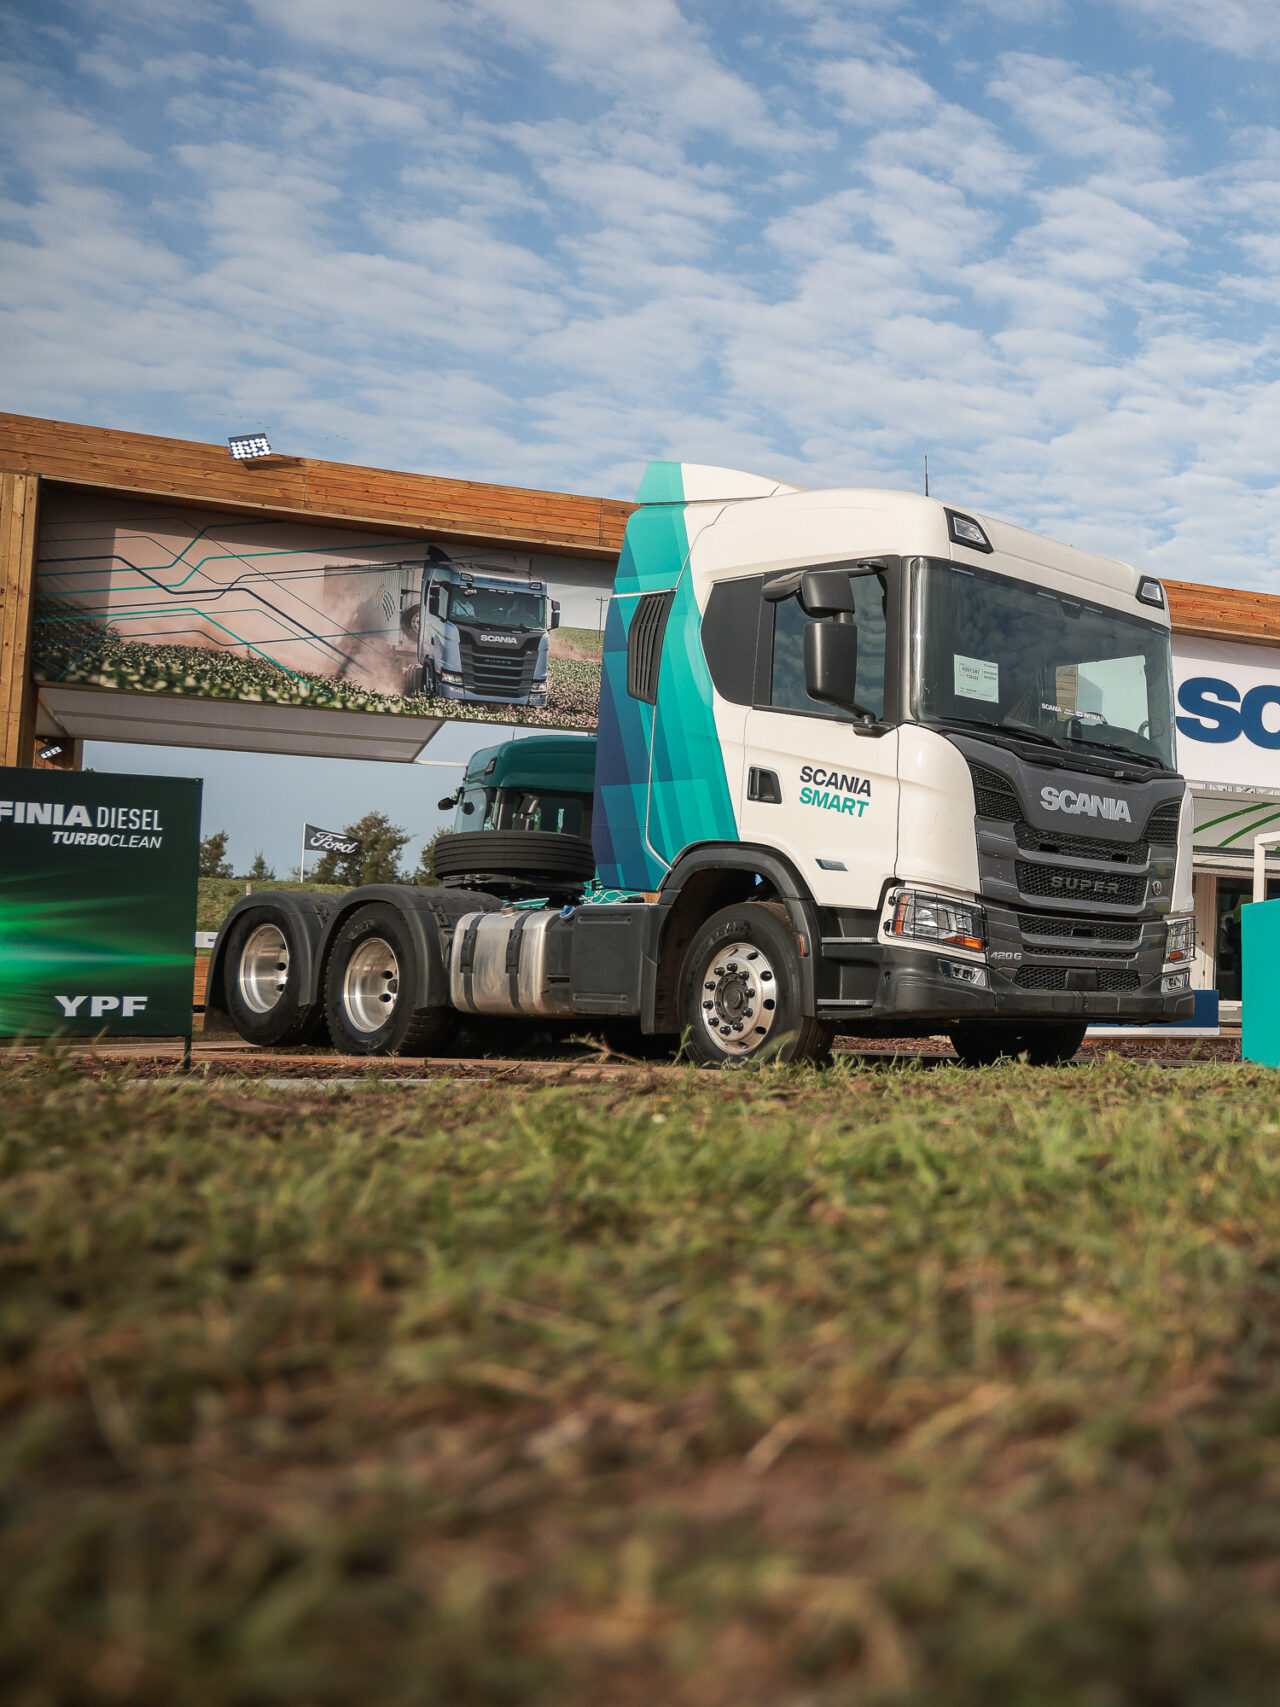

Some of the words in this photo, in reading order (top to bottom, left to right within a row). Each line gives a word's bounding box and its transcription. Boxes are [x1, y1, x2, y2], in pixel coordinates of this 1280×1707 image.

[480, 634, 517, 645] SCANIA
[800, 766, 871, 797] SCANIA
[800, 787, 869, 817] SMART
[1040, 786, 1132, 823] SCANIA
[97, 807, 163, 831] DIESEL
[52, 832, 163, 848] TURBOCLEAN
[310, 832, 358, 853] Ford
[1051, 876, 1119, 895] SUPER
[54, 995, 148, 1017] YPF
